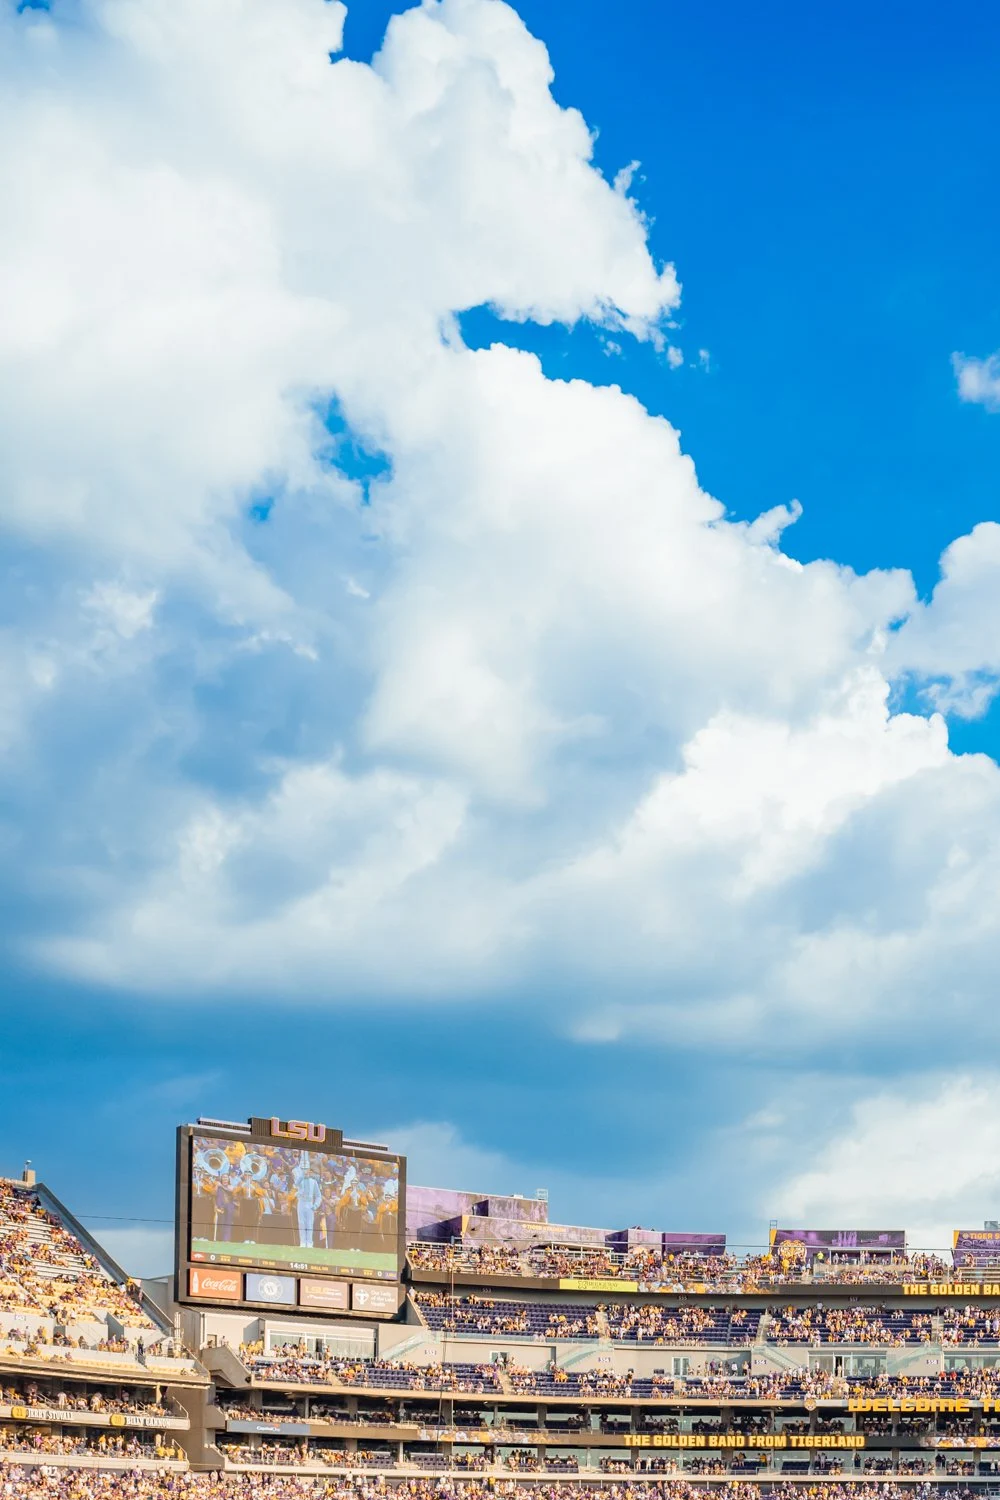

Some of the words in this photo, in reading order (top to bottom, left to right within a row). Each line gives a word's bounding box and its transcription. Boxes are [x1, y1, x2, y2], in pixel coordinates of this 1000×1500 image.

[271, 1117, 326, 1142] LSU
[290, 1262, 308, 1270] 14:51
[904, 1285, 927, 1296] THE
[930, 1285, 979, 1296] GOLDEN
[849, 1399, 969, 1412] WELCOME
[624, 1434, 650, 1447] THE
[653, 1434, 702, 1447] GOLDEN
[709, 1434, 745, 1447] BAND
[749, 1434, 787, 1447] FROM
[790, 1434, 865, 1448] TIGERLAND
